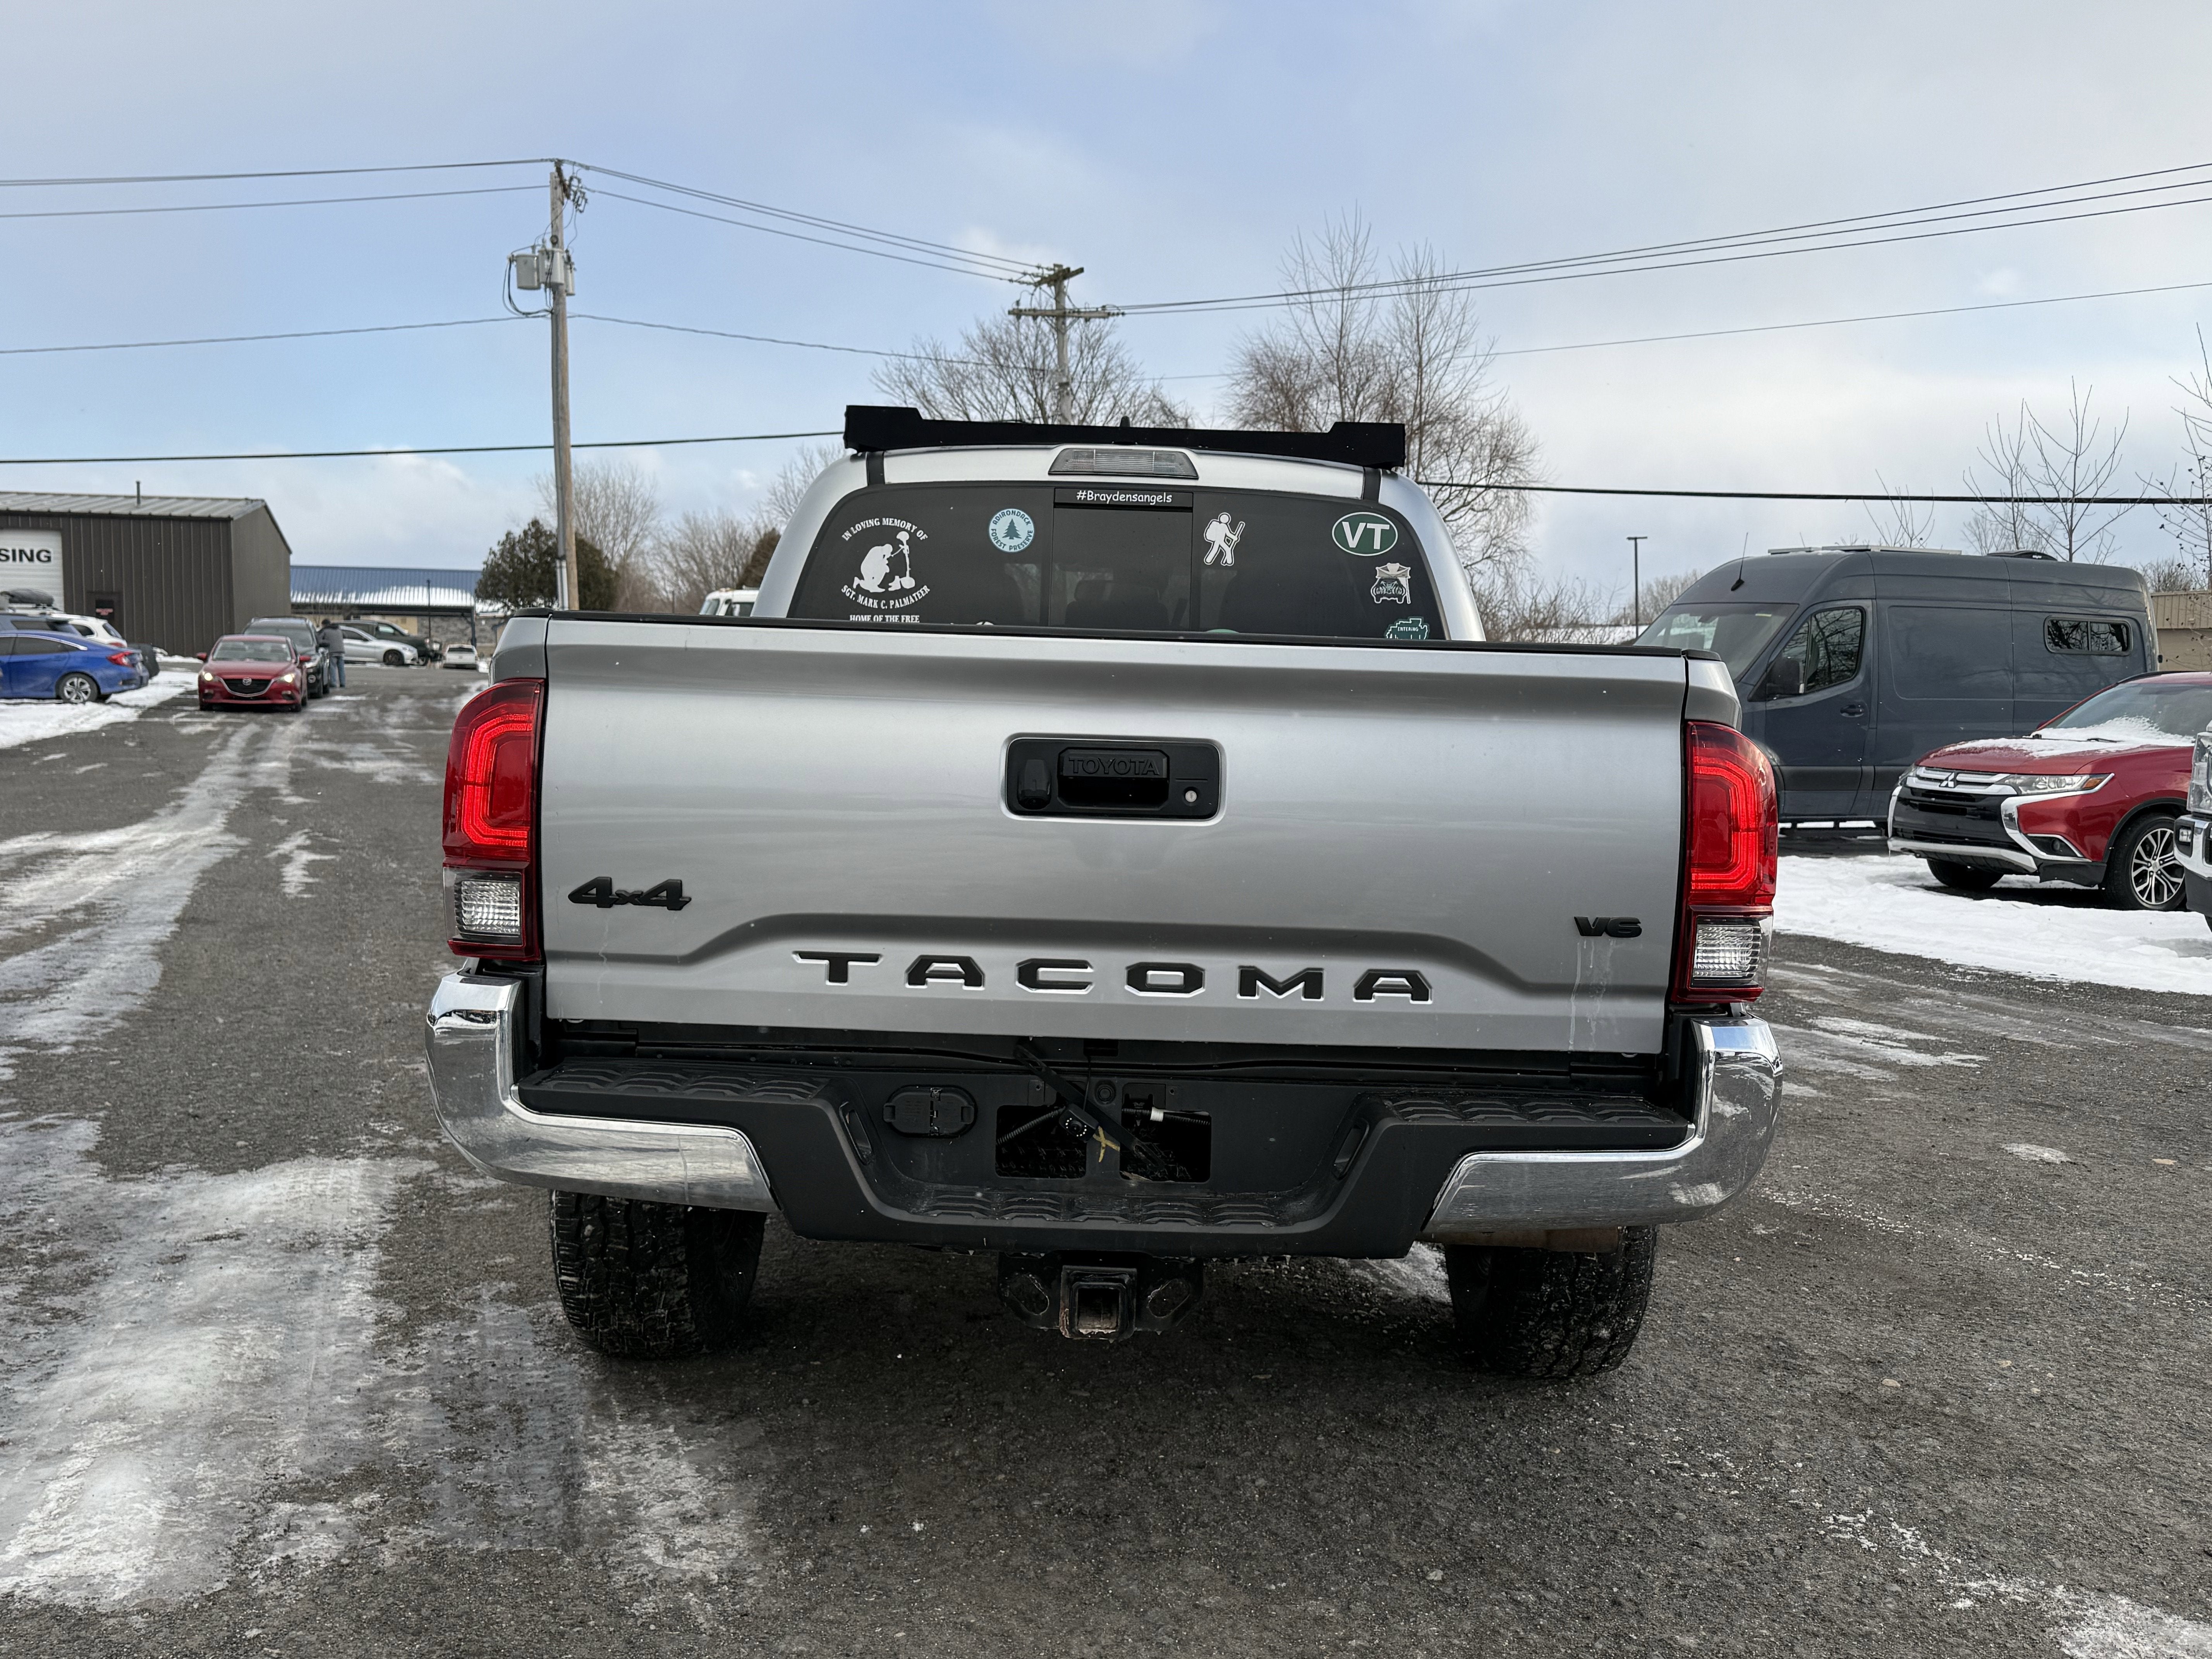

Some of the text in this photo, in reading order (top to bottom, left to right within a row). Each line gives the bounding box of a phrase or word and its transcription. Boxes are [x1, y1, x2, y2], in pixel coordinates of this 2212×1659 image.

[1077, 490, 1172, 505] #Braydensangels
[993, 510, 1031, 526] ADIRONDACK
[842, 518, 928, 541] IN LOVING MEMORY OF
[991, 529, 1033, 551] FOREST PRESERVE
[1342, 521, 1390, 550] VT
[841, 585, 930, 609] SGT. MARK C. PALMATEER
[1069, 757, 1160, 776] TOYOTA
[568, 876, 692, 910] 4x4
[1574, 916, 1642, 938] V6
[792, 951, 1432, 1004] TACOMA
